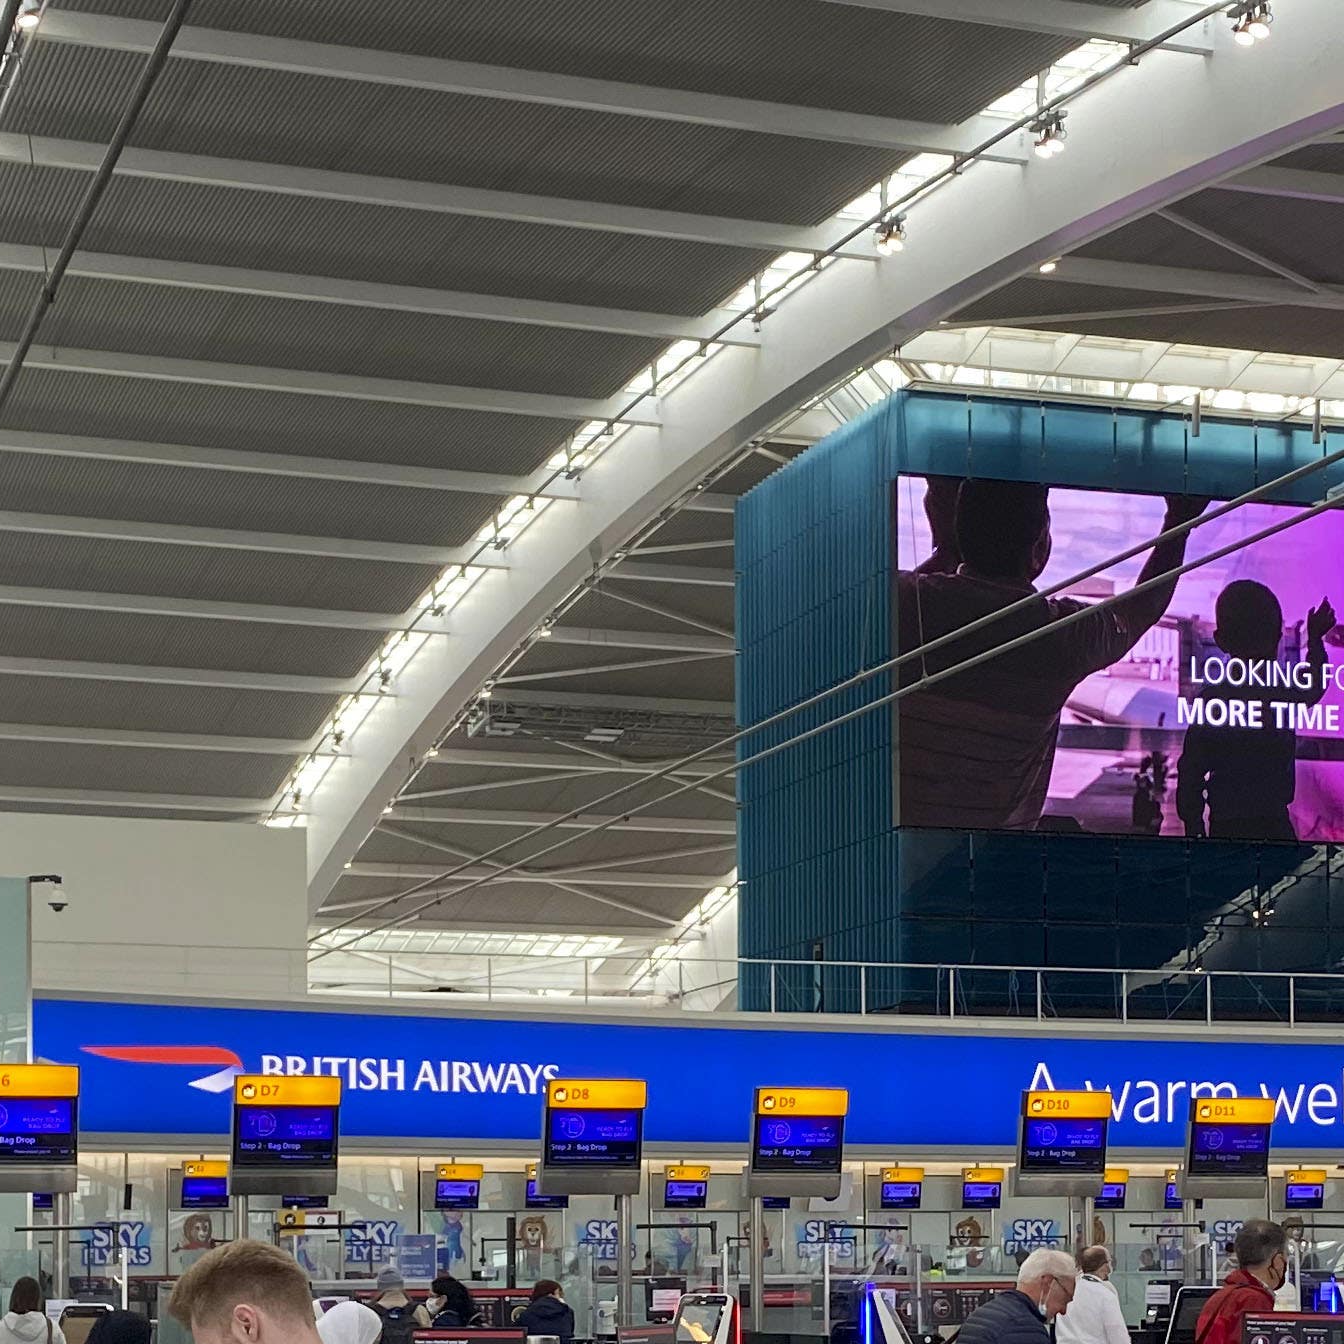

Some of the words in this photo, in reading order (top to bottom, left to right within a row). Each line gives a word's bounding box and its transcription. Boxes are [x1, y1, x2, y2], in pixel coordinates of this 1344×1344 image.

[1191, 656, 1312, 690] LOOKING
[1177, 697, 1262, 727] MORE
[1270, 701, 1339, 731] TIME
[261, 1055, 404, 1091] BRITISH
[414, 1061, 560, 1095] AIRWAYS
[260, 1085, 280, 1096] D7
[571, 1089, 589, 1099] D8
[779, 1097, 796, 1107] D9
[1047, 1099, 1070, 1110] D10
[1214, 1106, 1236, 1116] D11
[0, 1136, 14, 1145] Bag
[16, 1136, 36, 1145] Drop
[352, 1222, 396, 1246] SKY
[587, 1221, 618, 1240] SK
[1014, 1221, 1052, 1241] SKY
[83, 1248, 150, 1265] FLYRS
